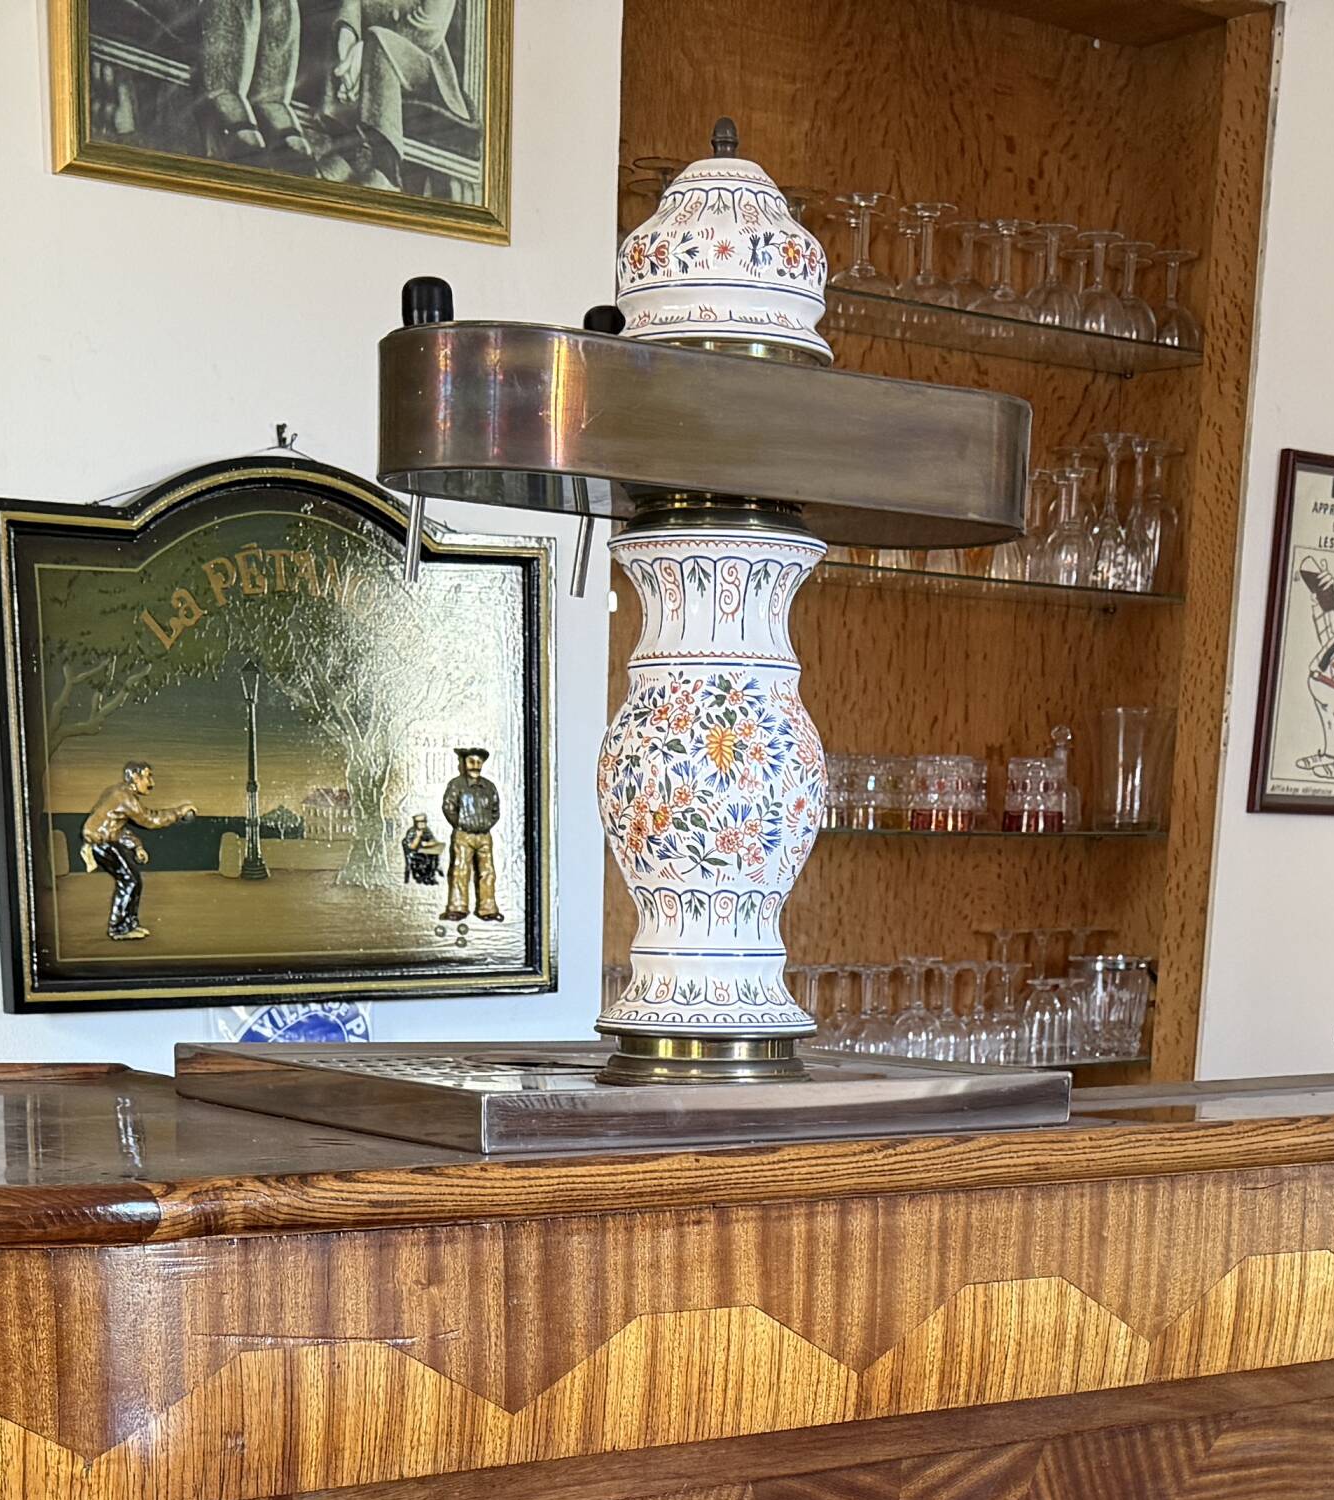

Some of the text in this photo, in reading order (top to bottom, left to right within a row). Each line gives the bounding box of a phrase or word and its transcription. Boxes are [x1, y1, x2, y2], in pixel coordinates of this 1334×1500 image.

[1318, 536, 1334, 549] LES
[141, 543, 379, 650] La PÉTAN
